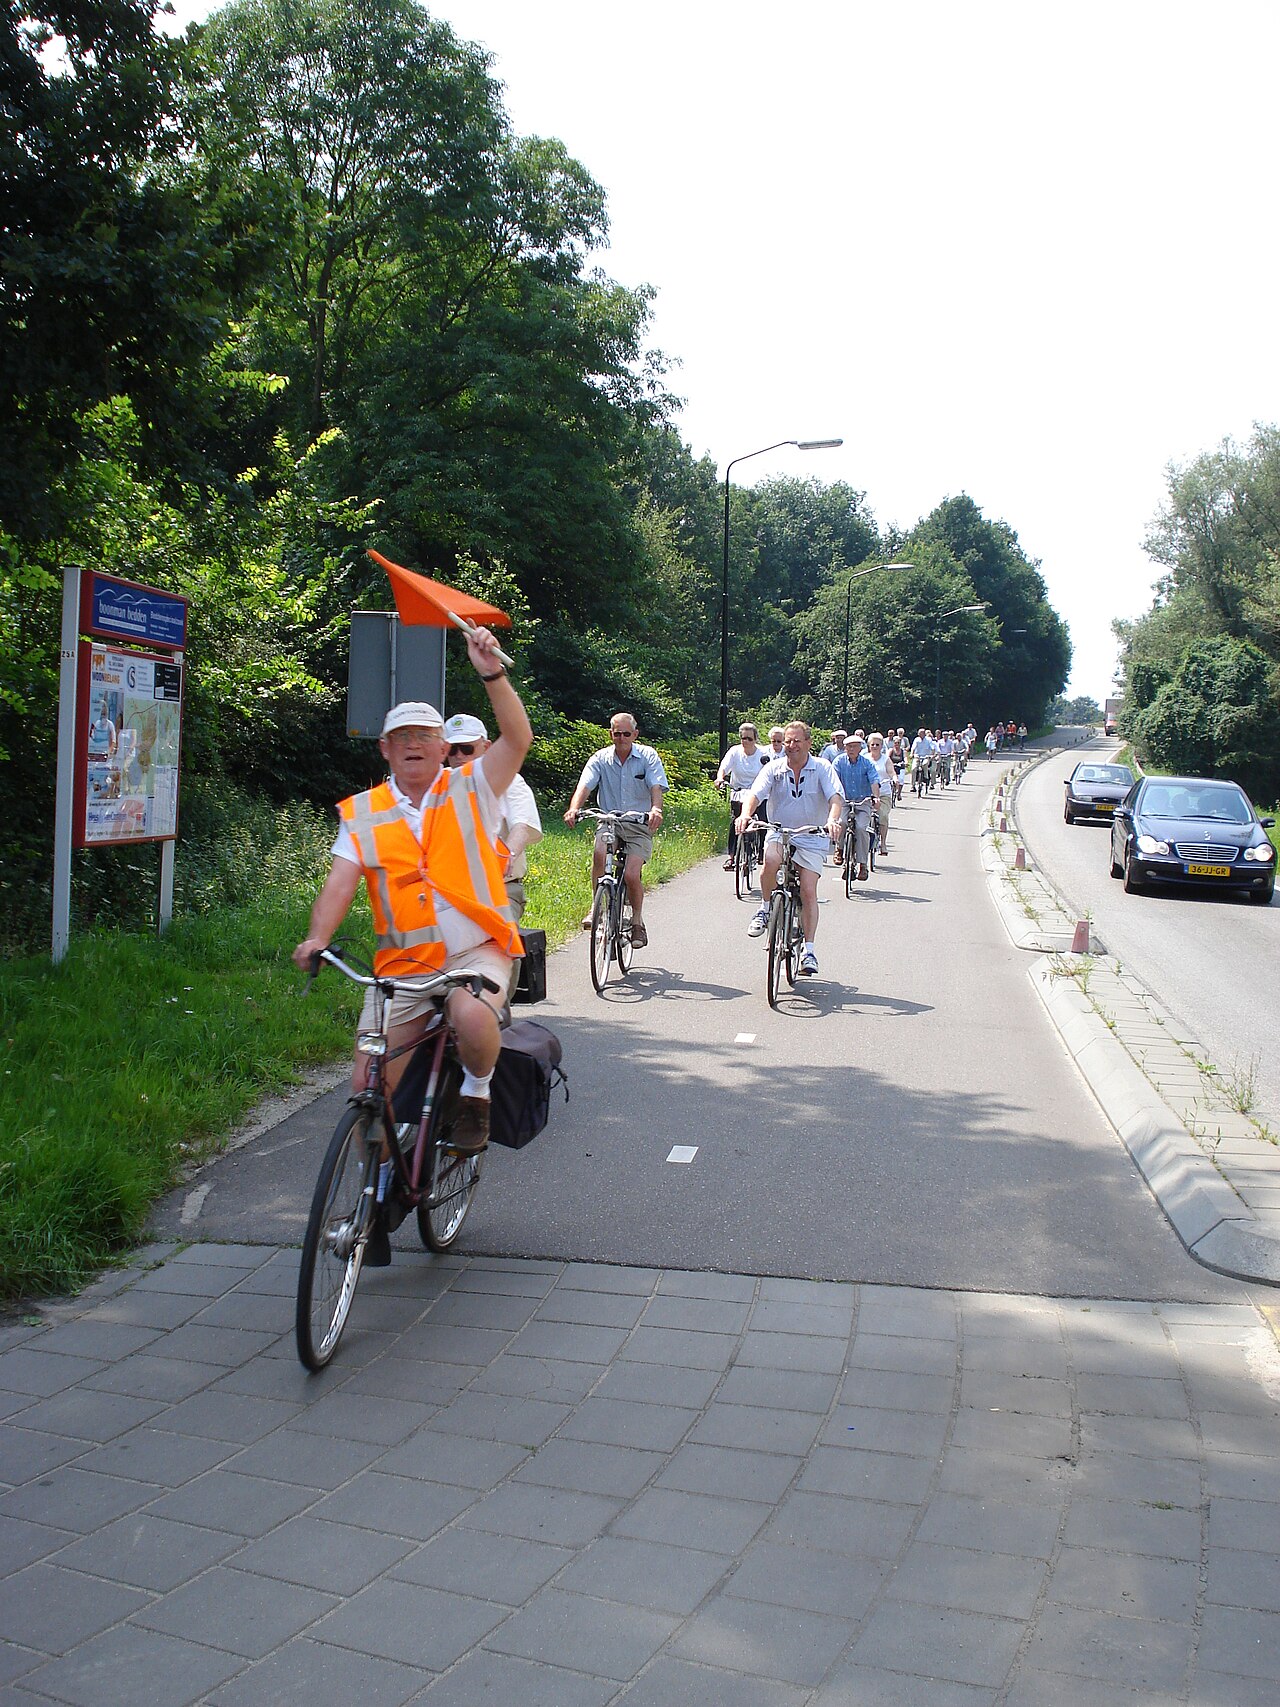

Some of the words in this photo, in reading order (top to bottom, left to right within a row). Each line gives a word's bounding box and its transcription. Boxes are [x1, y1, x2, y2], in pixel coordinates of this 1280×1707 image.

[127, 605, 147, 623] bedden
[92, 672, 120, 684] WOONBELANG
[1192, 866, 1226, 875] 36-JJ-GR
